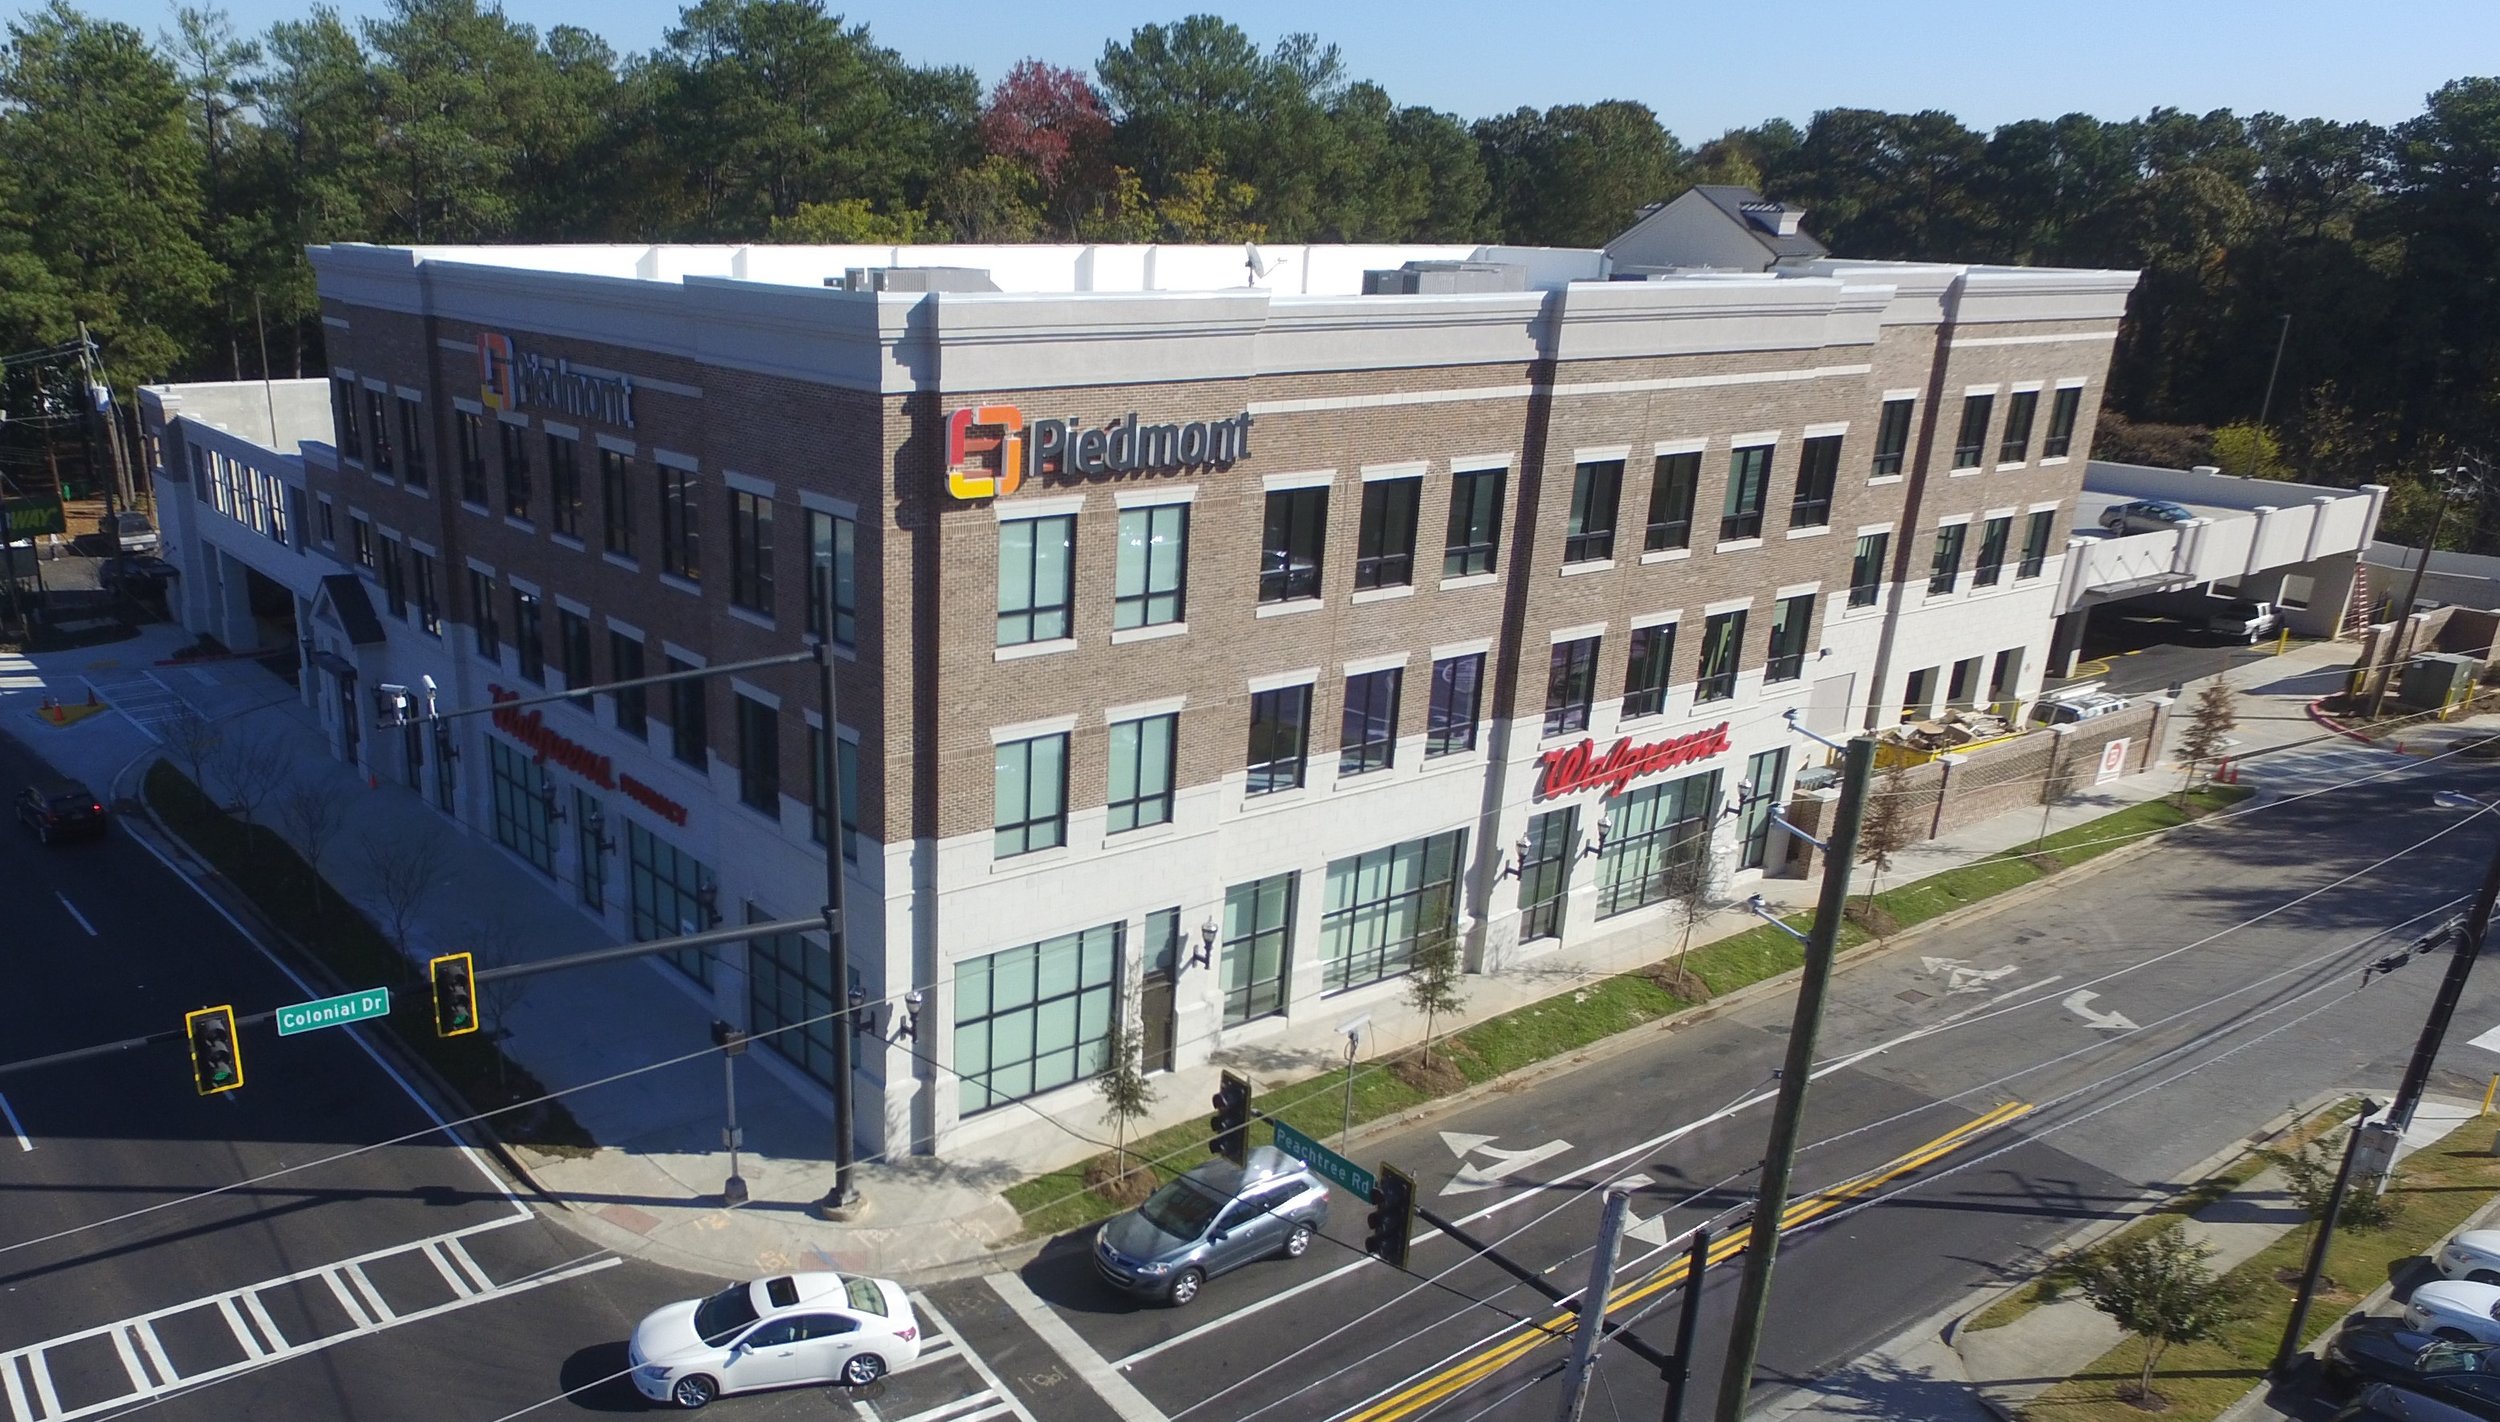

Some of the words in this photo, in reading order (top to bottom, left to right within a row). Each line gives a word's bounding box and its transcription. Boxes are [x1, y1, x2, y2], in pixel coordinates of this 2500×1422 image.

[515, 352, 635, 429] Piedmont
[1030, 411, 1253, 477] Piedmont
[1543, 721, 1732, 799] Walgreens
[283, 1001, 356, 1028] Colonial
[361, 997, 382, 1012] Dr
[1276, 1128, 1347, 1180] Peachtree
[1351, 1171, 1370, 1194] Rd
